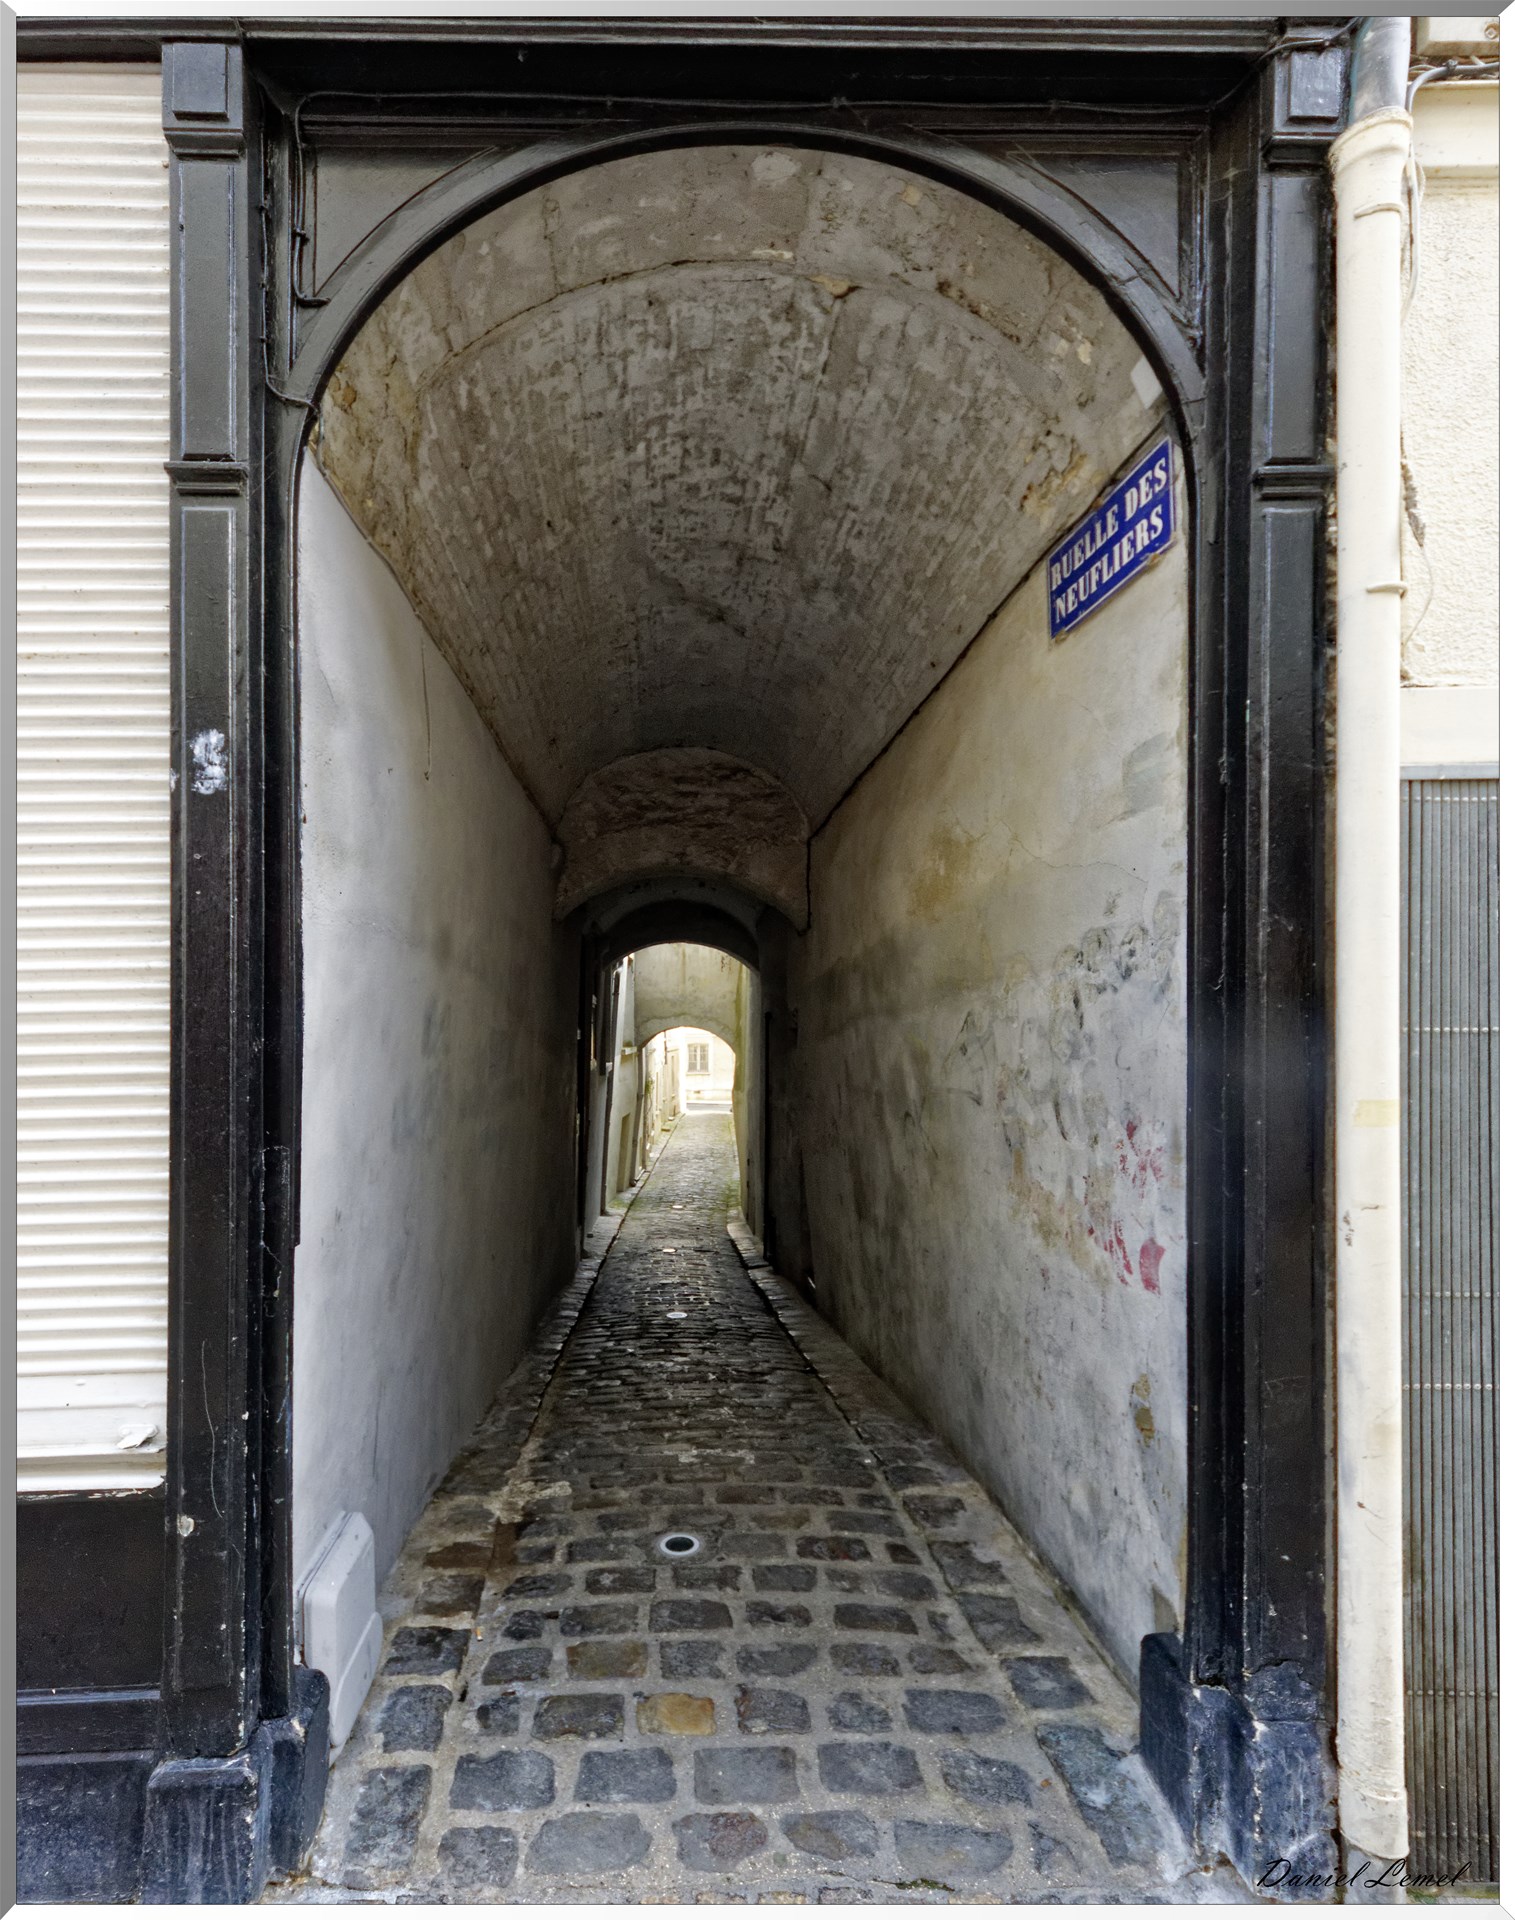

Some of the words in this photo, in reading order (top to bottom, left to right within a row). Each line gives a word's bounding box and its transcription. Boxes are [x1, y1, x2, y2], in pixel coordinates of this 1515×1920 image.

[1051, 505, 1119, 591] RUELLE
[1125, 457, 1167, 521] DES
[1055, 504, 1163, 624] NEUFLIERS
